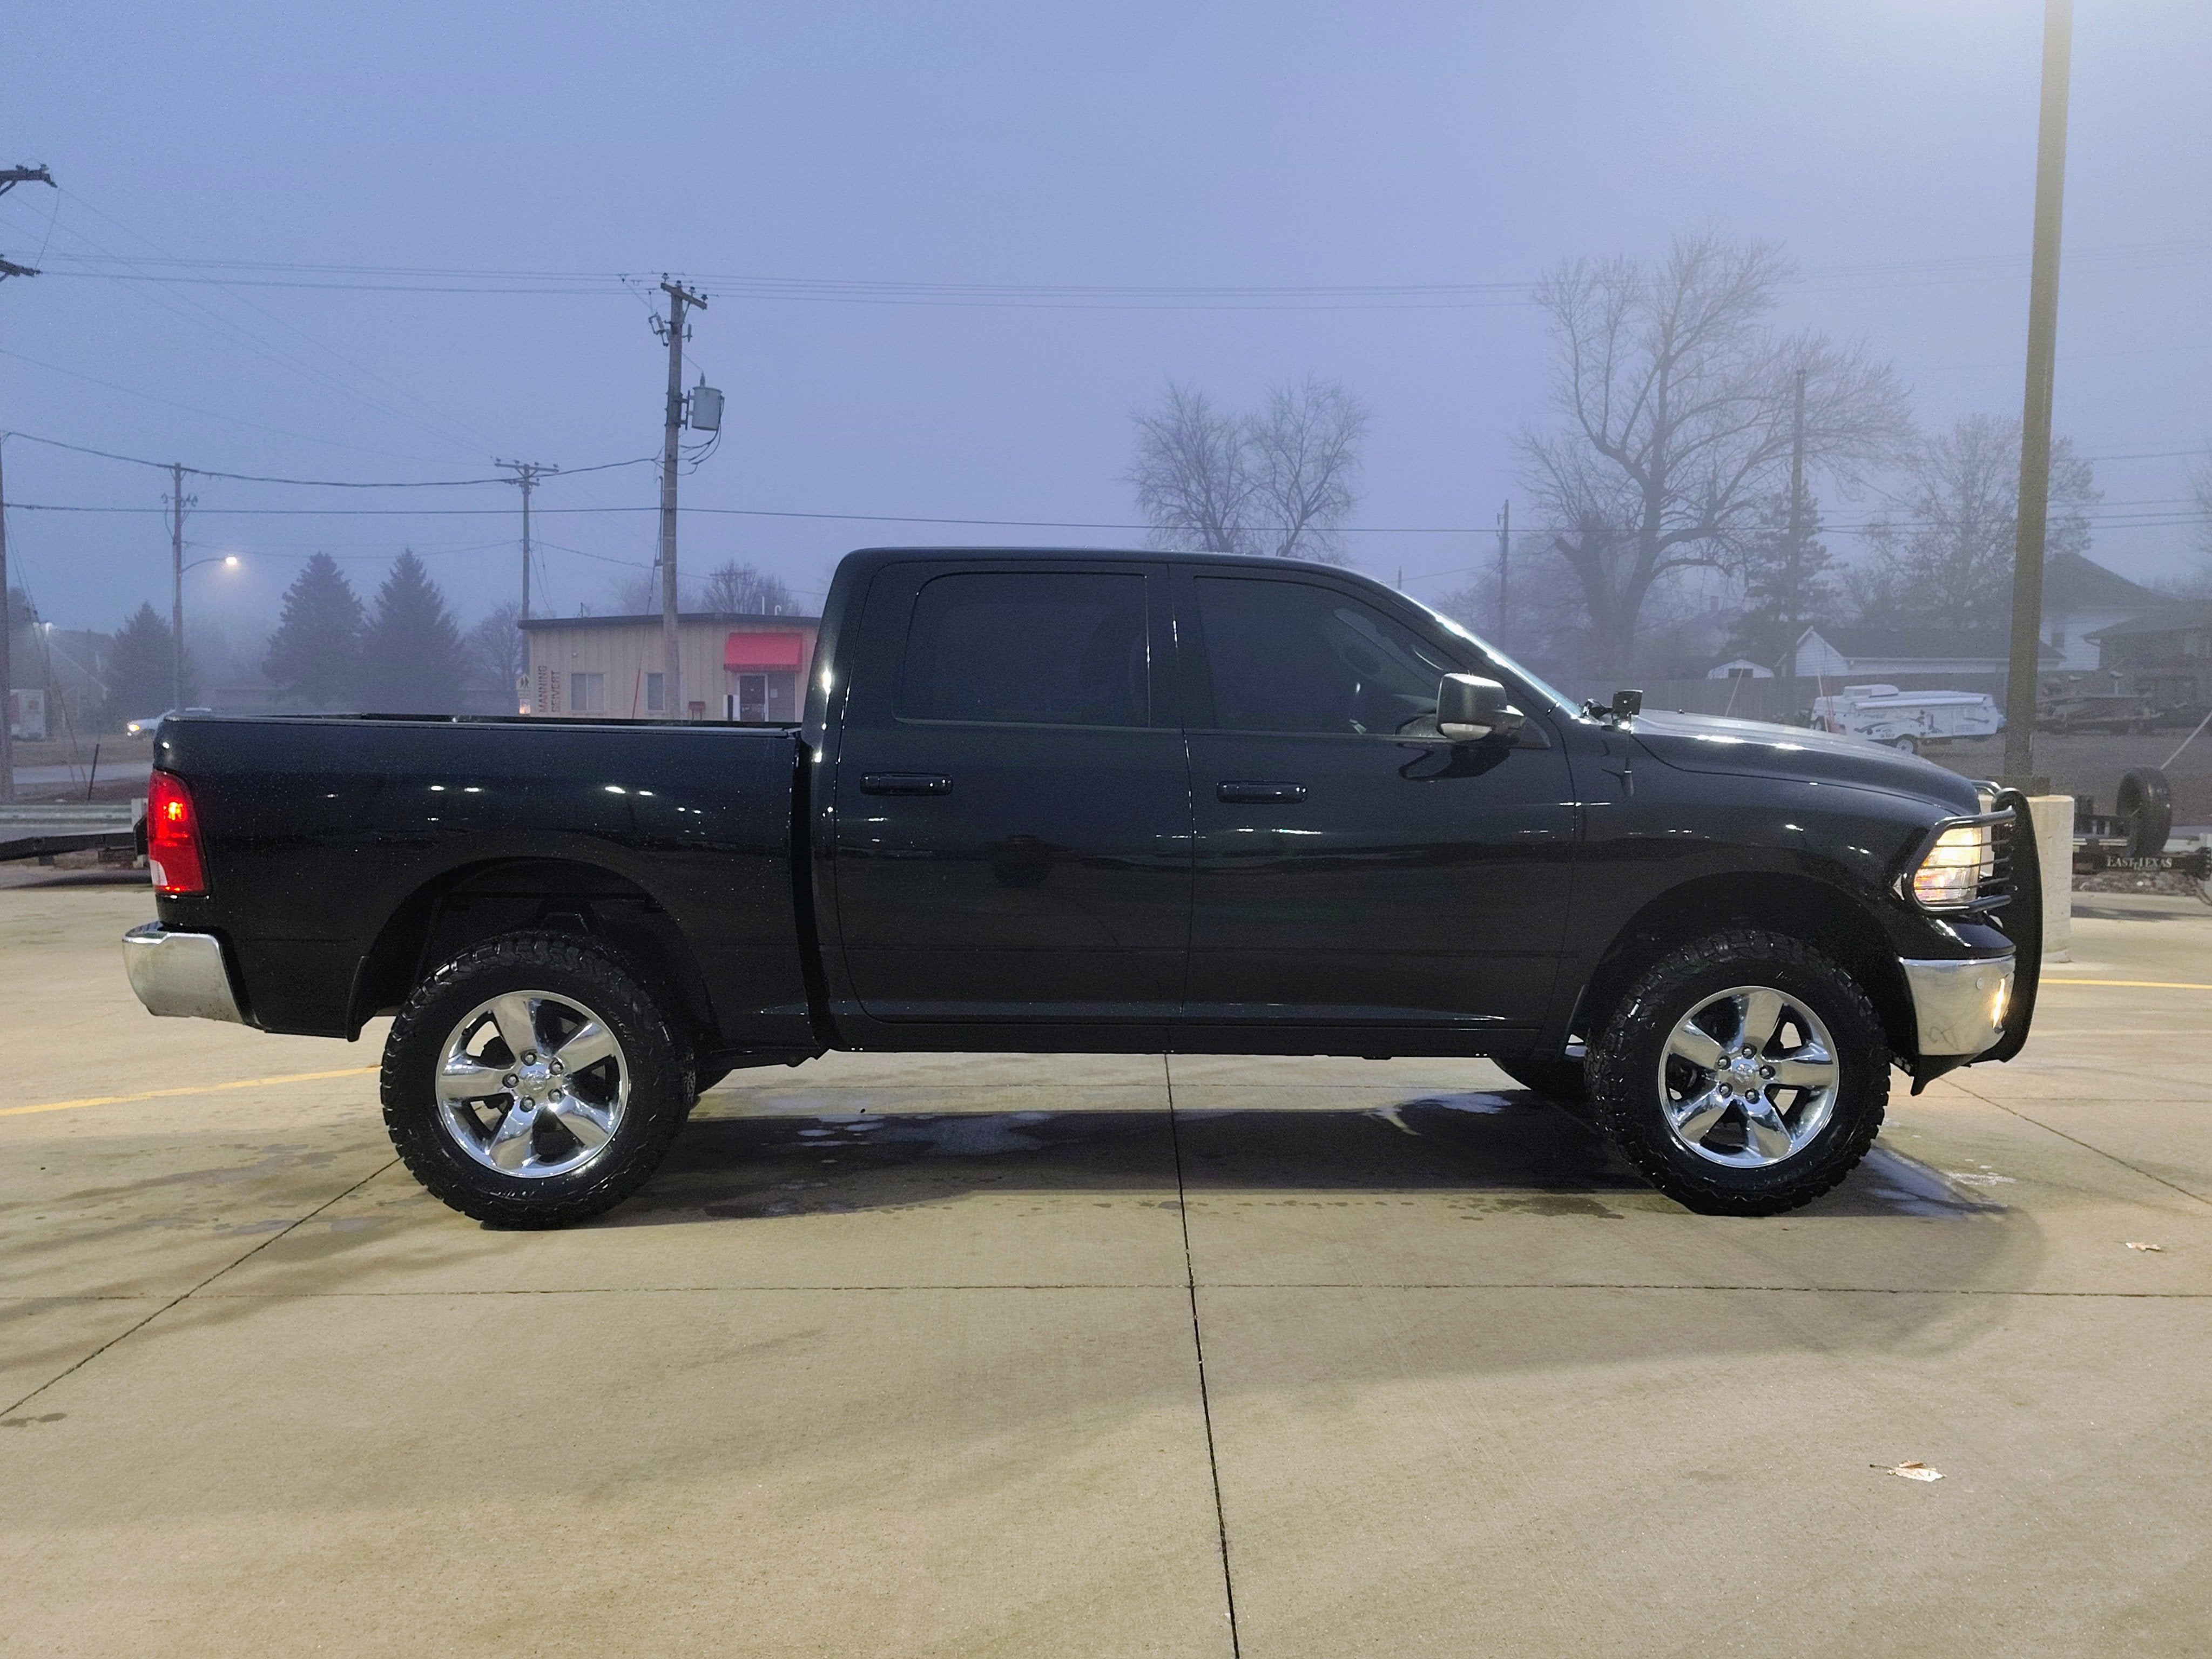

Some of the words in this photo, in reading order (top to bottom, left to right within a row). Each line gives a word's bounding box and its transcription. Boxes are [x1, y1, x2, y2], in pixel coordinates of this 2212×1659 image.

[538, 665, 547, 712] MANNING
[2107, 856, 2135, 867] EAST
[2139, 857, 2172, 868] TEXAS
